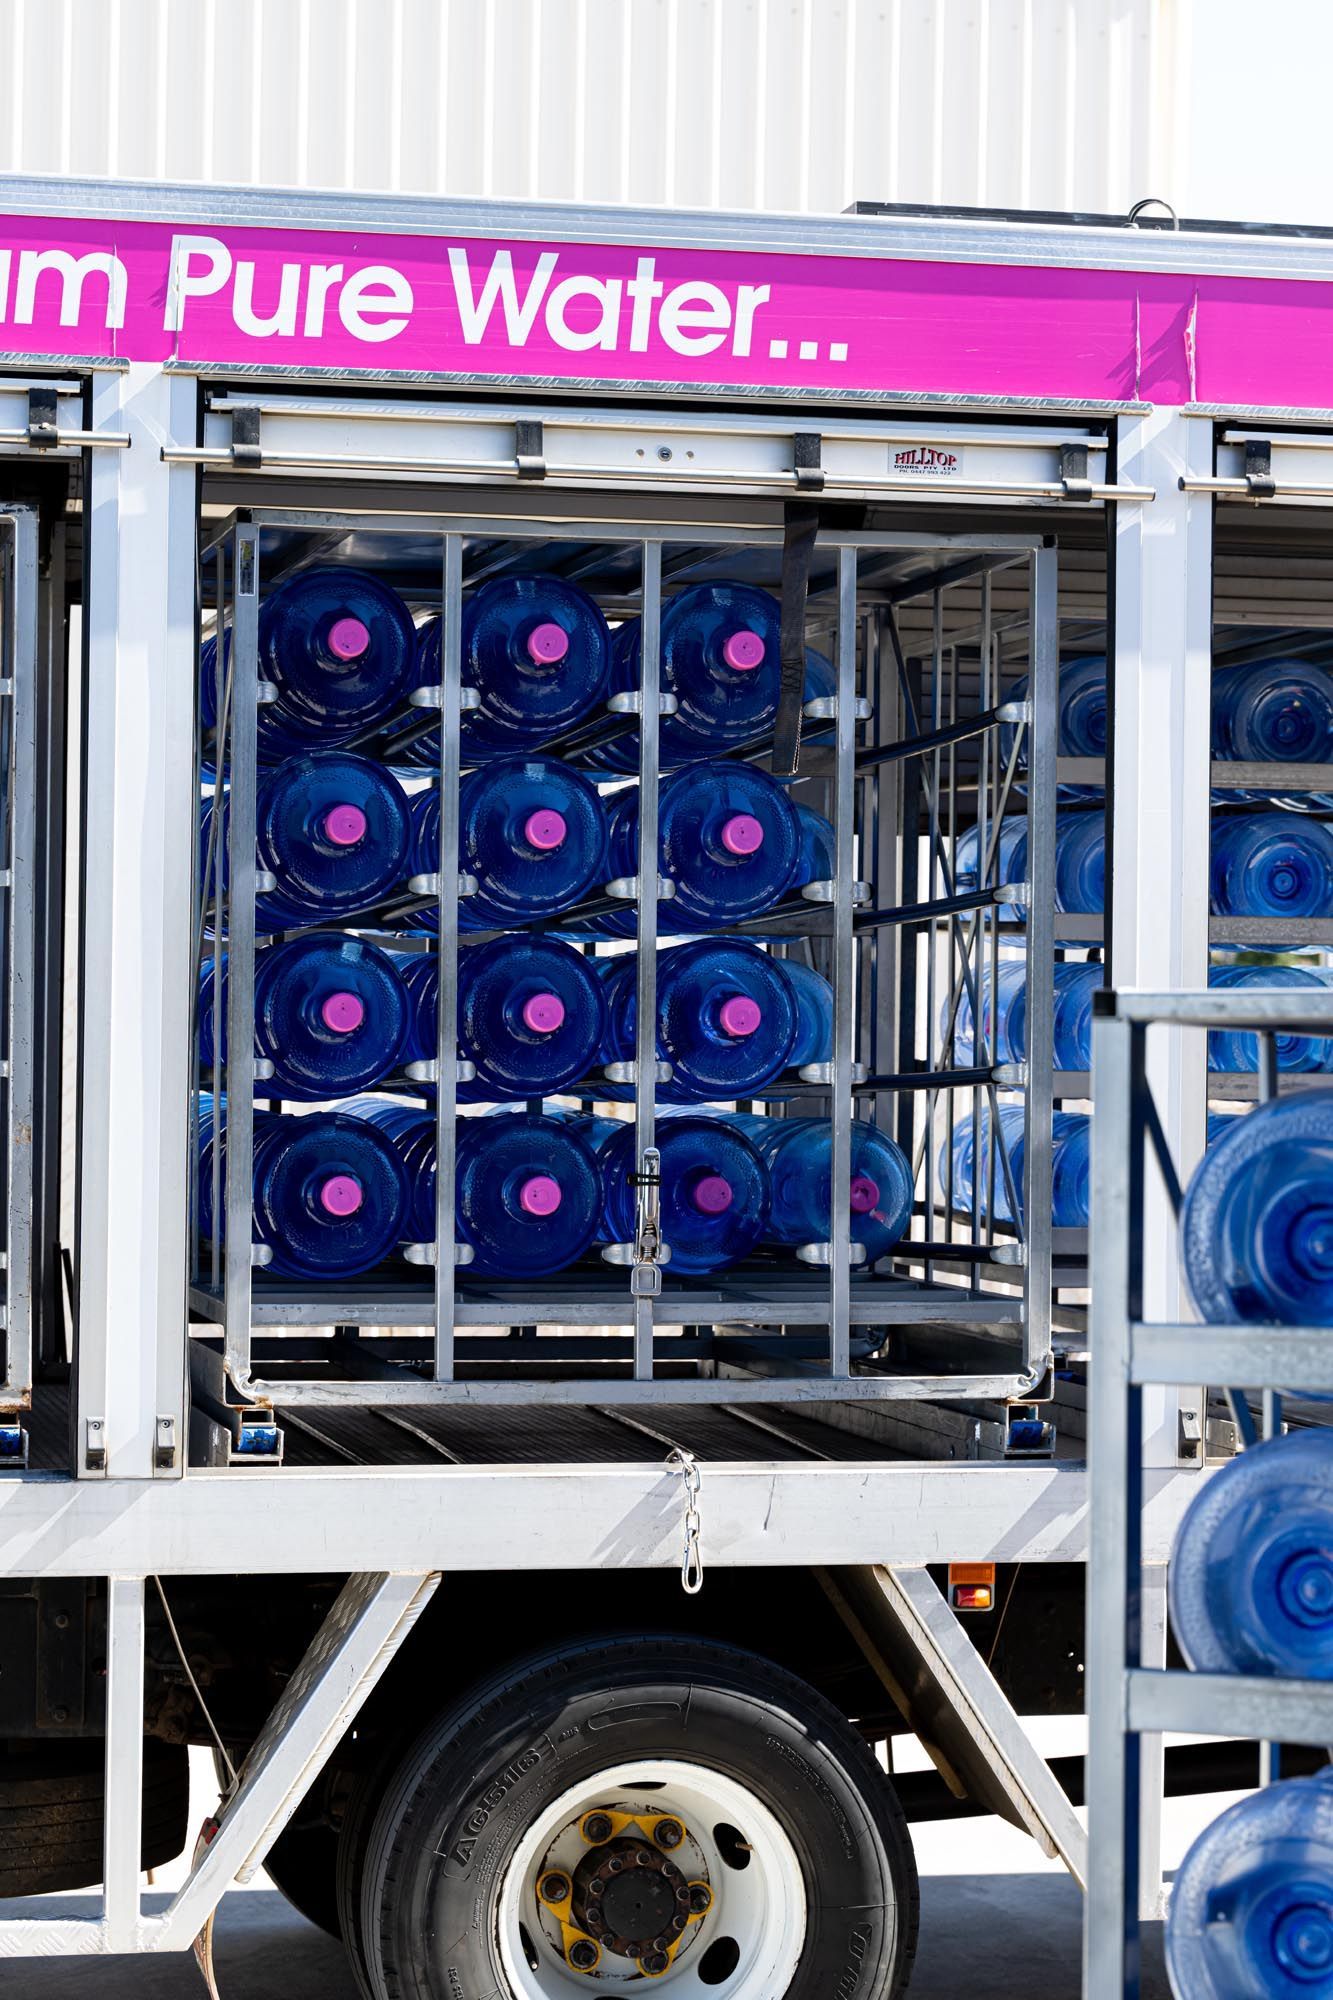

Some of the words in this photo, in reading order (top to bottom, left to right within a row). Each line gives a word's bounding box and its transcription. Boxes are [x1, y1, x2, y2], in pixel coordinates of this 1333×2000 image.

[0, 248, 128, 329] m
[164, 234, 413, 346] Pure
[895, 447, 957, 466] HILLTOP
